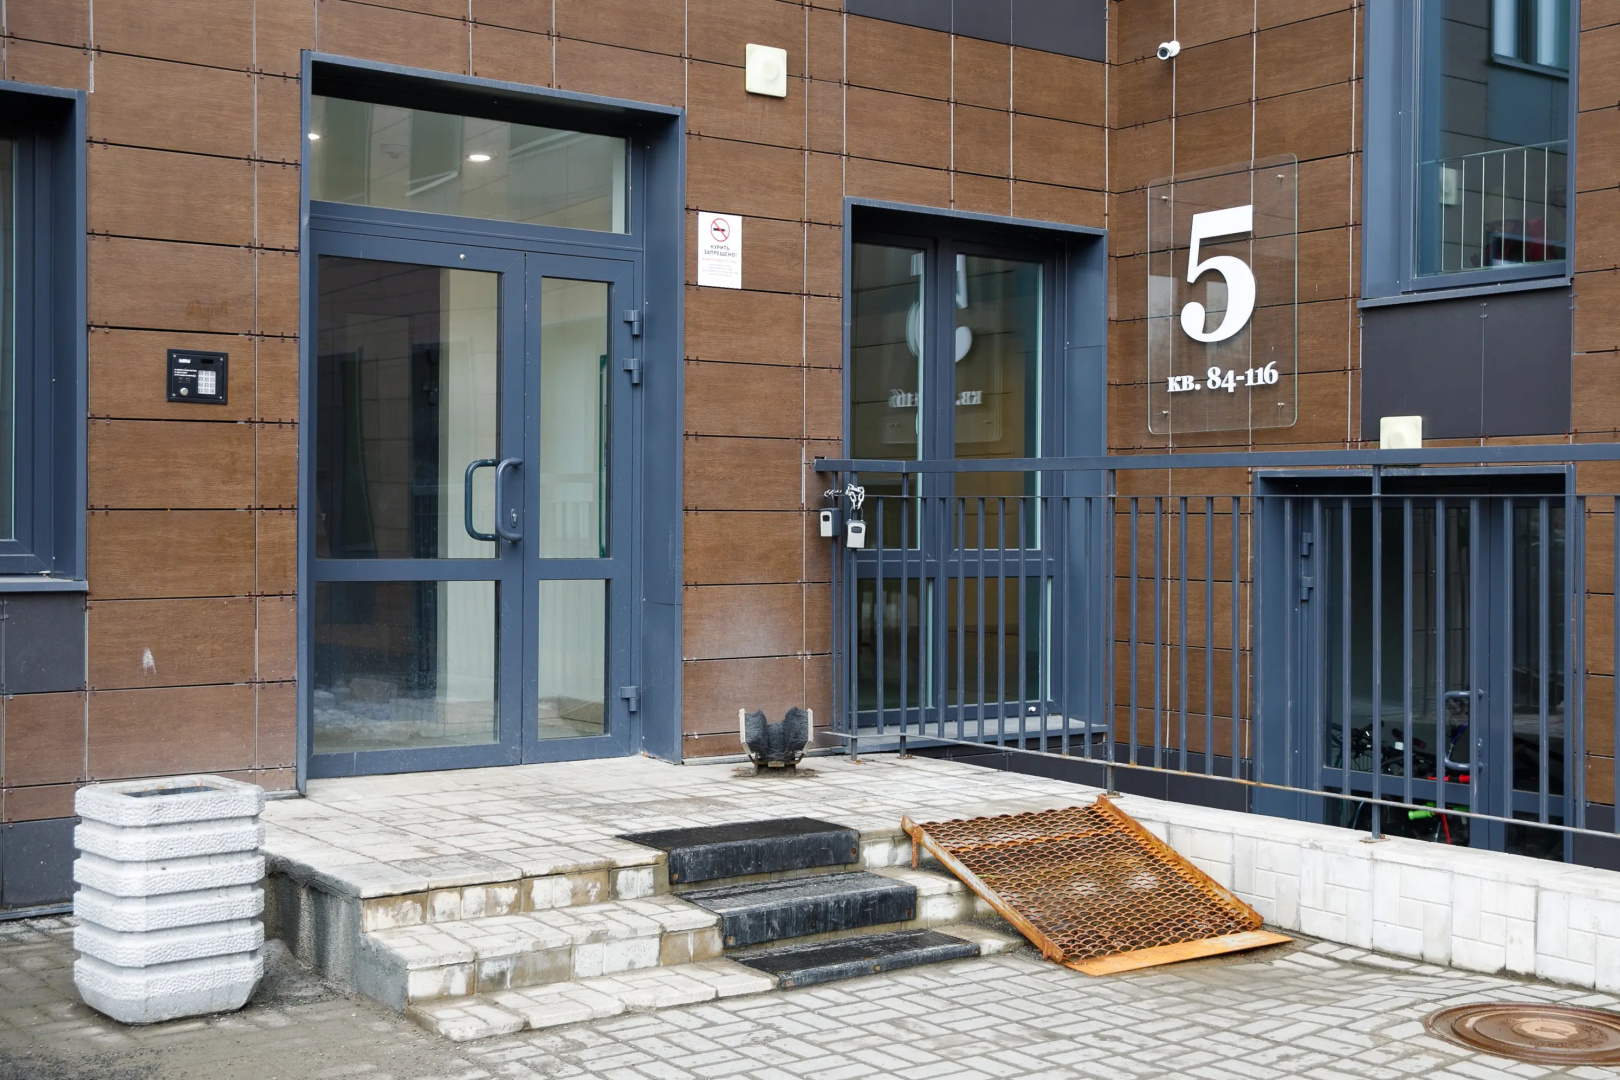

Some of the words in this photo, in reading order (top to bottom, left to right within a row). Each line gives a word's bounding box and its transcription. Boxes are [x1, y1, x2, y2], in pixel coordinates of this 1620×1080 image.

[1181, 205, 1256, 342] 5
[1167, 375, 1201, 393] кв.
[1207, 361, 1279, 393] 84-116
